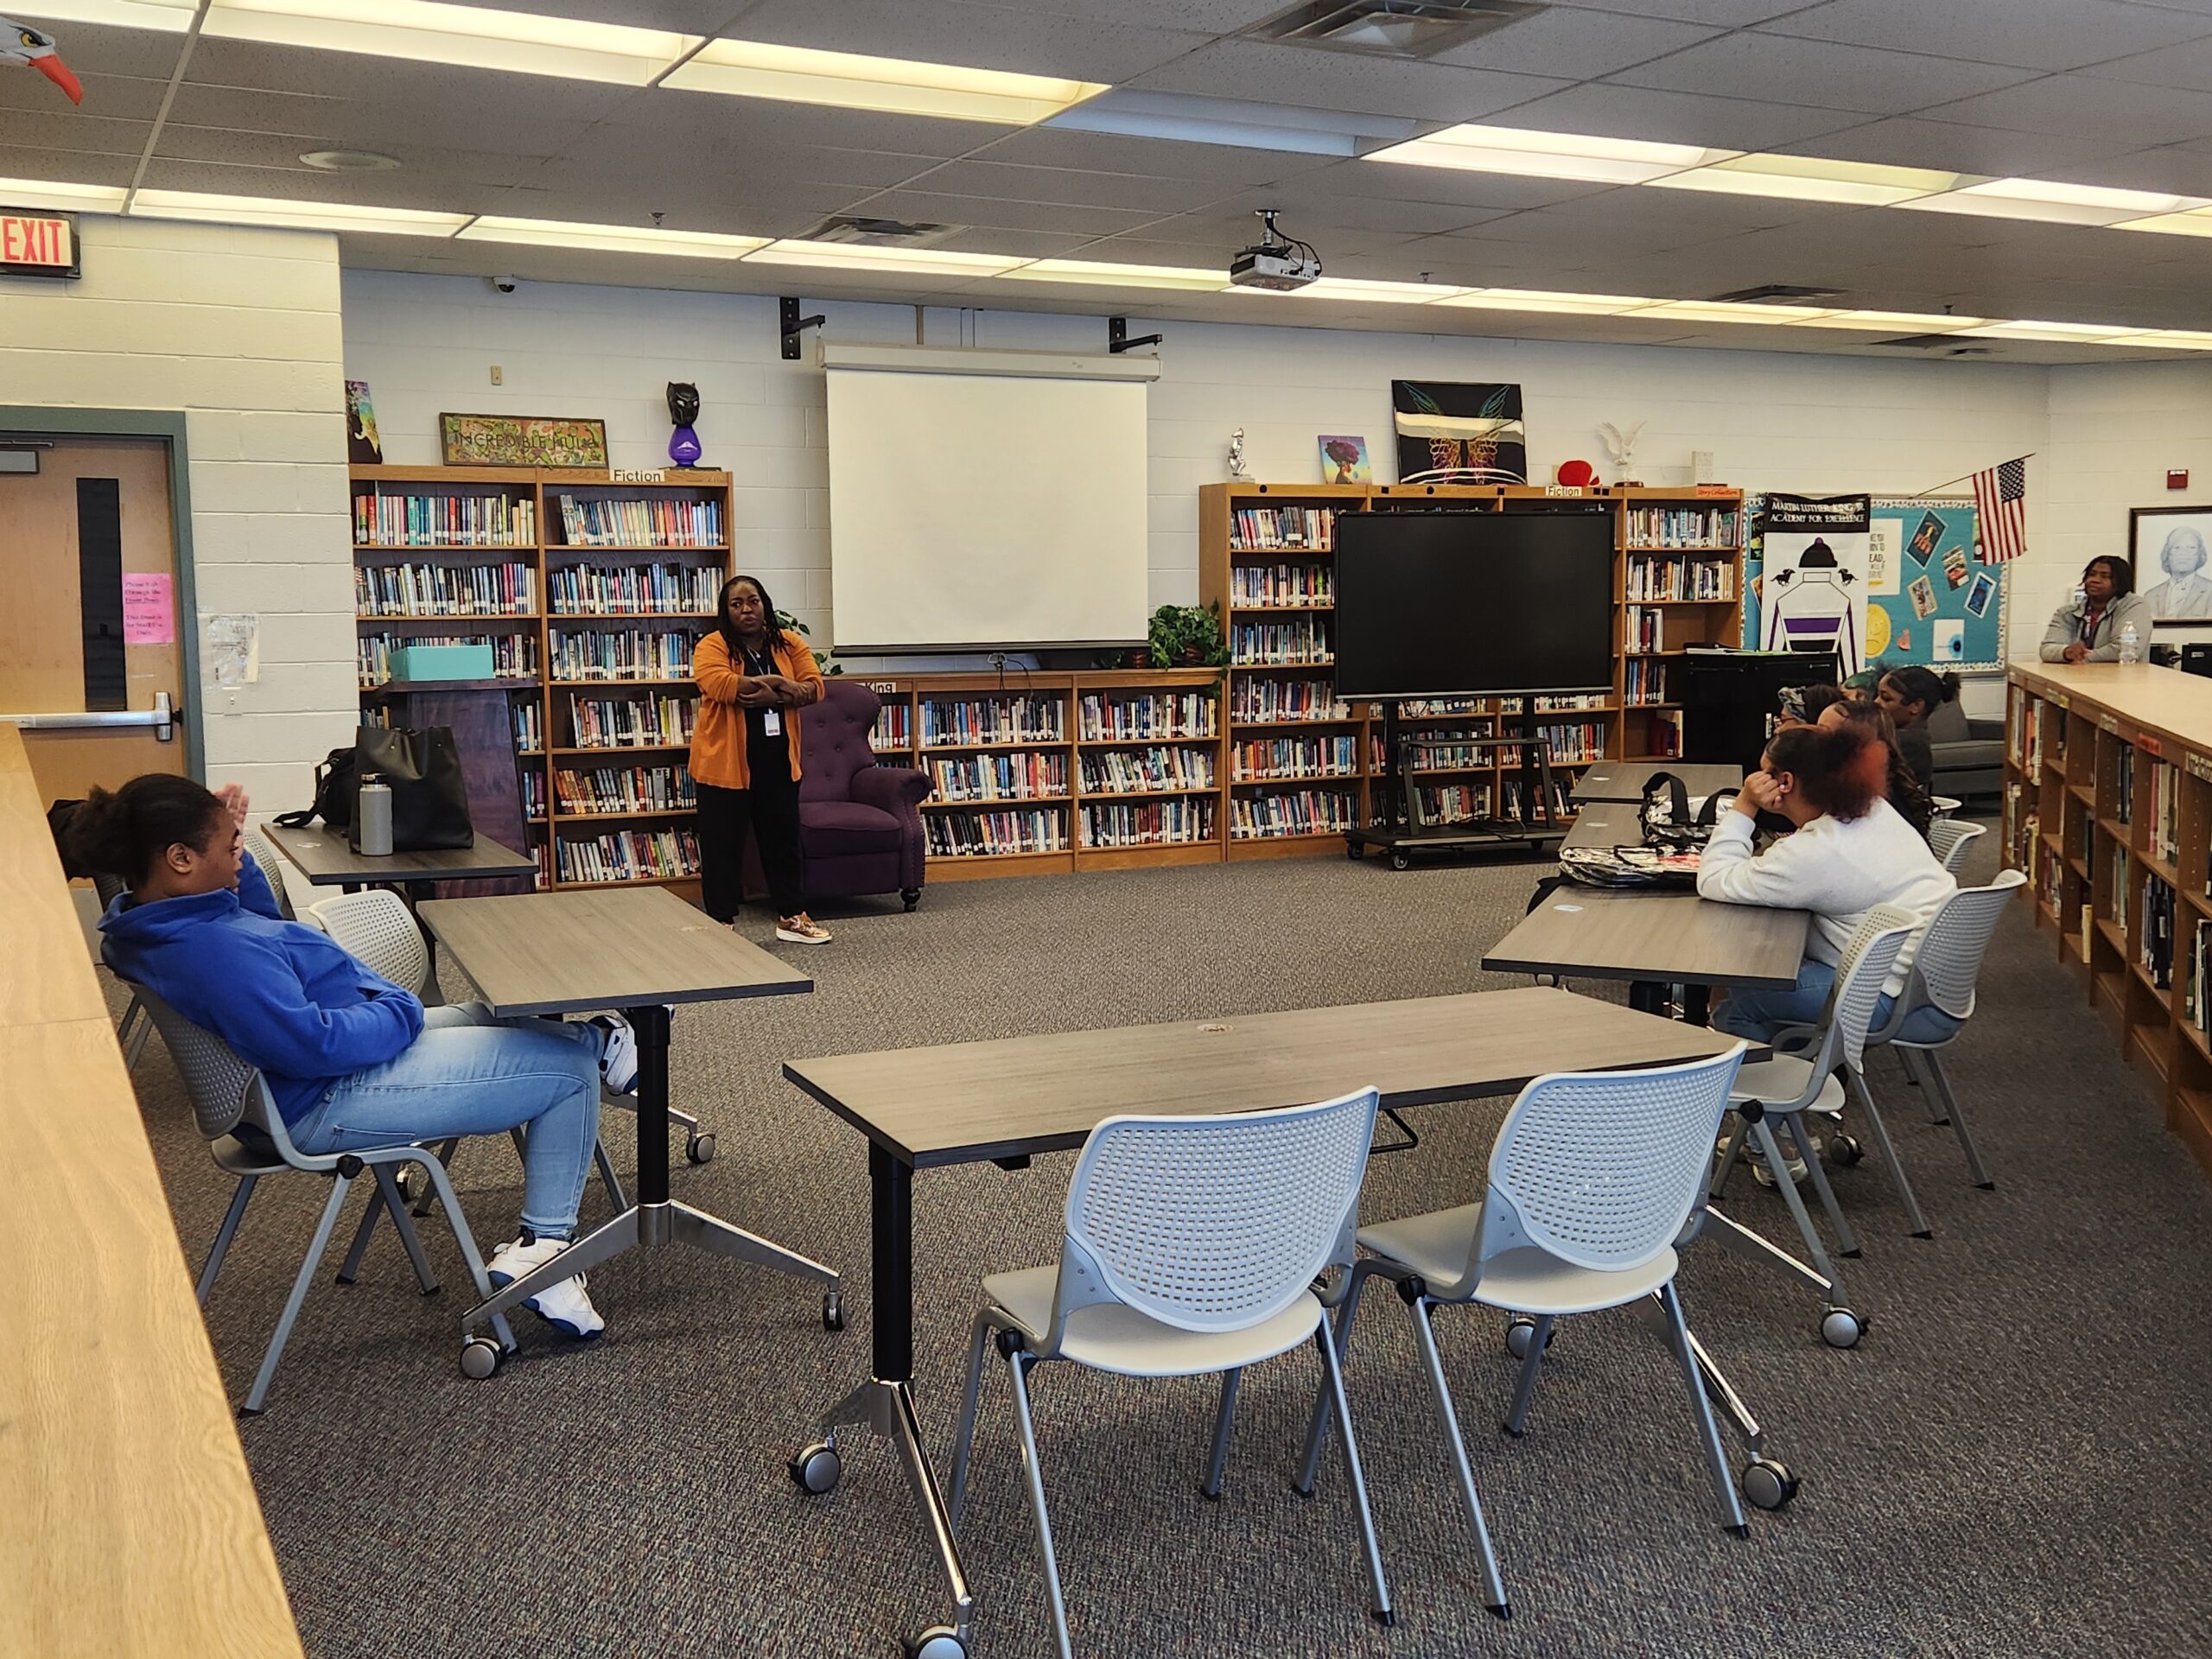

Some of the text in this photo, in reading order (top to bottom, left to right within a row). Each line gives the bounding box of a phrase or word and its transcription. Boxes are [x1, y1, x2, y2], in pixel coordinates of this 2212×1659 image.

[3, 218, 62, 264] EXIT
[453, 430, 545, 450] INCREDIBLE
[613, 469, 661, 482] Fiction
[1548, 486, 1580, 497] Fiction
[1771, 501, 1800, 512] MARTIN
[1801, 504, 1830, 512] LUTHER
[1770, 513, 1866, 523] ACADEMY FOR EXCELLENCE
[866, 681, 893, 694] King
